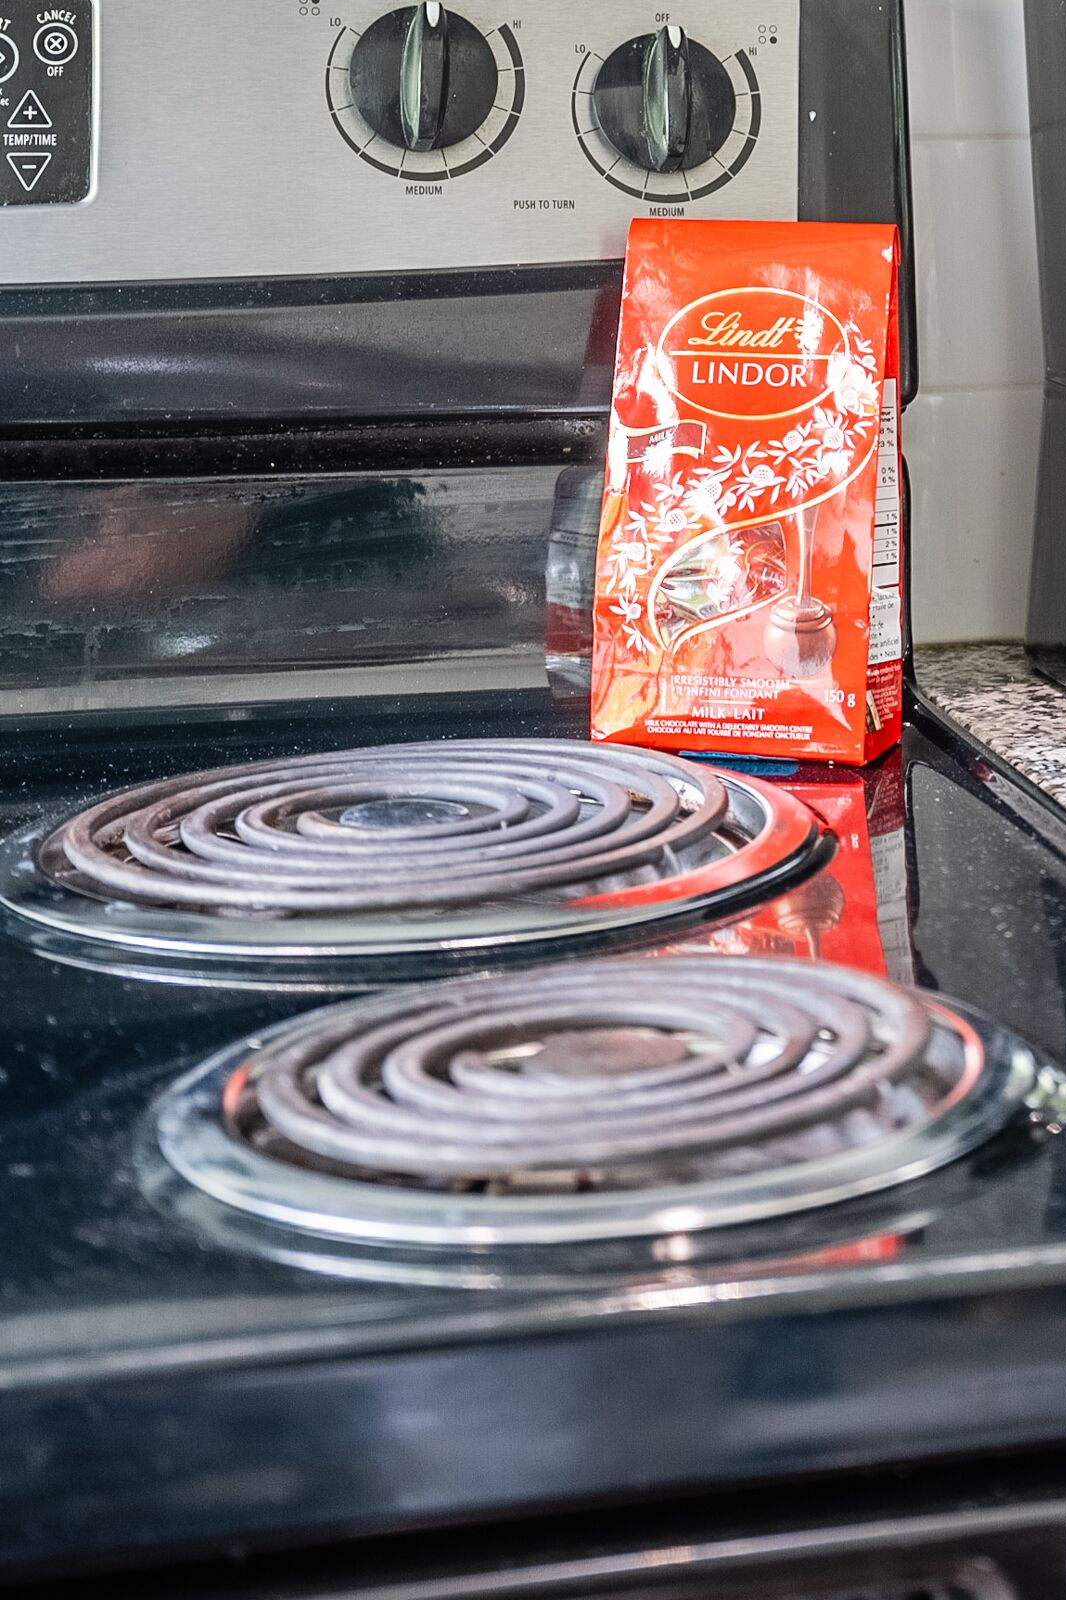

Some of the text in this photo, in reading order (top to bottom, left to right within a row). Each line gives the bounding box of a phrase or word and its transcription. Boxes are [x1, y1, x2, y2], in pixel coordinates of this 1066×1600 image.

[36, 9, 76, 25] CANCEL
[330, 18, 341, 27] LO
[655, 13, 670, 22] OFF
[513, 20, 522, 29] HI
[575, 44, 586, 53] LO
[749, 47, 758, 56] HI
[46, 66, 64, 77] OFF
[3, 134, 57, 146] TEMP/TIME
[405, 186, 442, 195] MEDIUM
[514, 200, 575, 210] PUSH TO TURN
[649, 208, 685, 217] MEDIUM
[688, 311, 796, 348] Lindt
[692, 361, 807, 387] LINDOR
[670, 675, 790, 690] IRRESISTIBLY SMOOTH
[724, 687, 779, 699] FONDANT
[824, 690, 856, 707] 150 g
[692, 706, 765, 720] MILK LAIT
[644, 719, 660, 727] MILK
[660, 720, 698, 729] CHOCOLATE
[760, 724, 788, 732] SMOOTH
[647, 726, 682, 734] CHOCOLAT
[682, 727, 693, 735] AU
